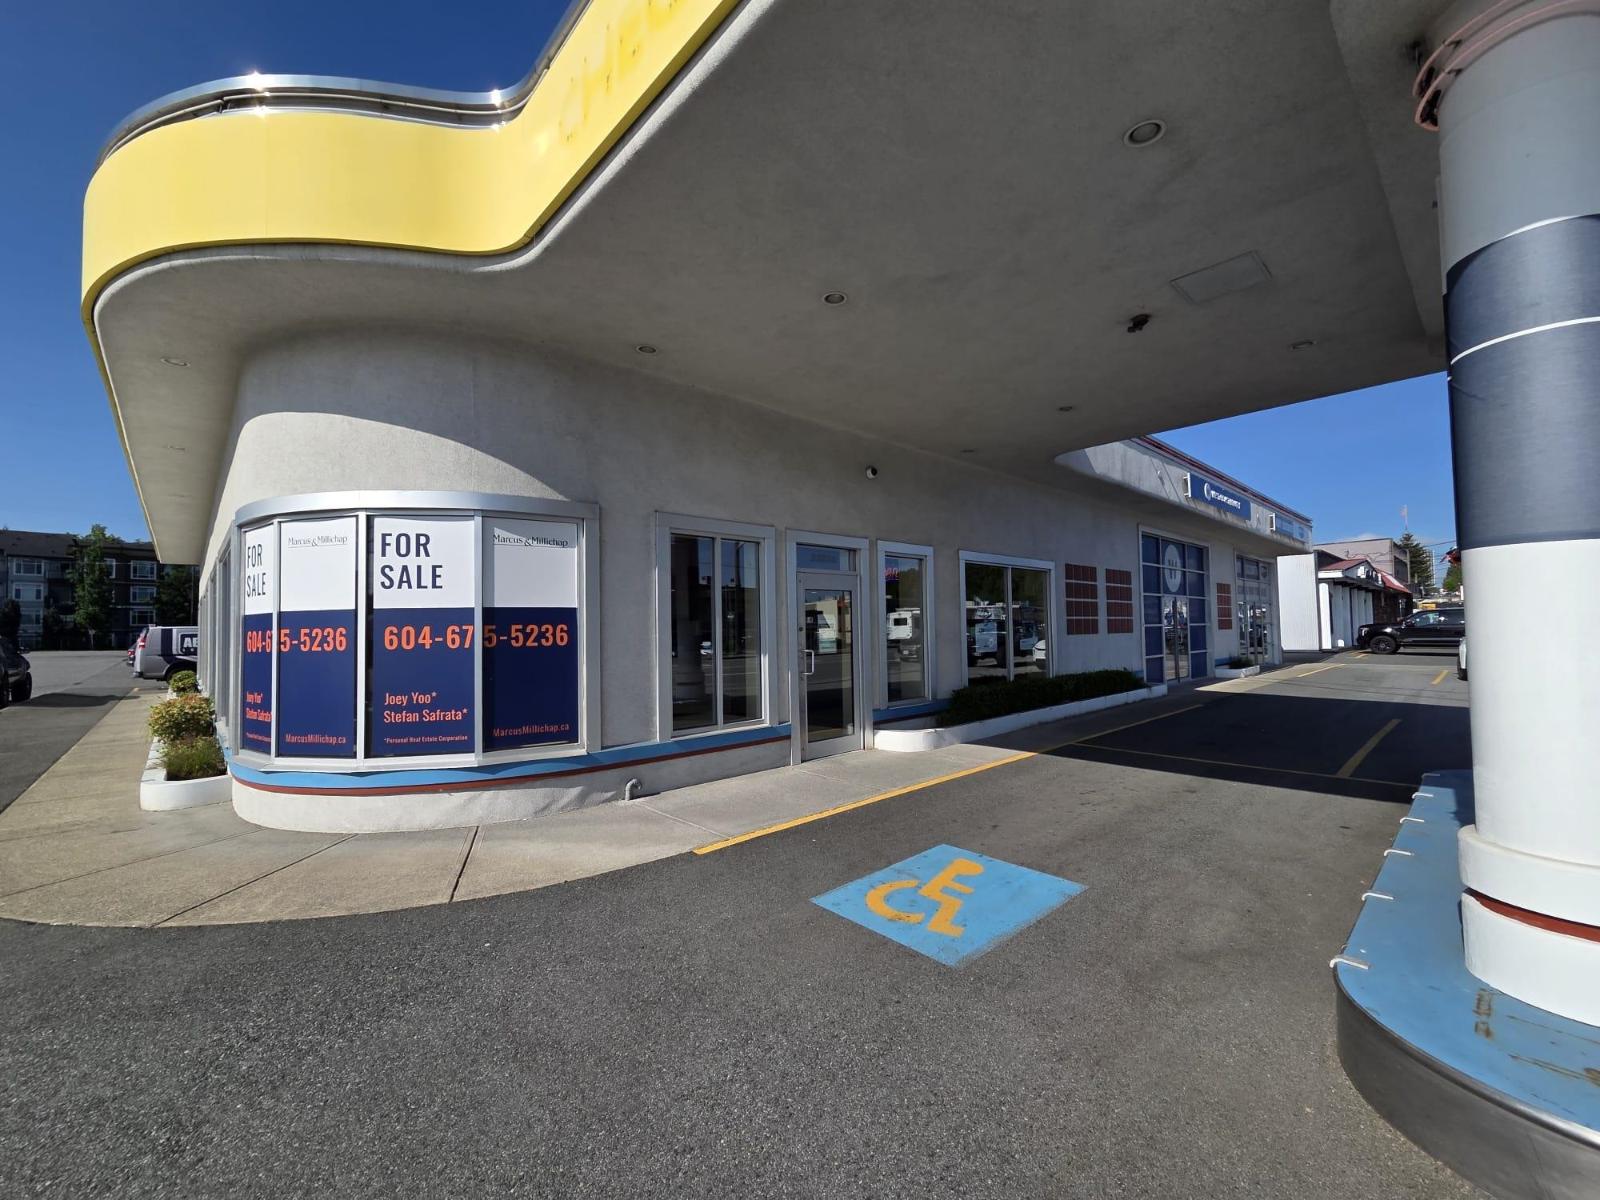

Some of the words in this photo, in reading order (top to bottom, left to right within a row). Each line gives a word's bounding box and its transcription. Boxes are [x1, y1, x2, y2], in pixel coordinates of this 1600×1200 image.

[288, 536, 311, 546] Marcus
[317, 534, 348, 546] Millichap
[381, 533, 431, 558] FOR
[492, 534, 523, 544] Marcus
[531, 536, 569, 548] Millichap
[247, 543, 263, 569] FOR
[380, 564, 443, 590] SALE
[246, 572, 267, 598] SALE
[246, 627, 348, 653] 604-65-5236
[384, 623, 569, 650] 604-675-5236
[384, 692, 408, 707] Joey
[383, 710, 419, 723] Stefan
[492, 723, 570, 737] MarcusMillichap.ca
[285, 733, 346, 745] MarcusMillichap.ca
[438, 735, 468, 743] Corporation
